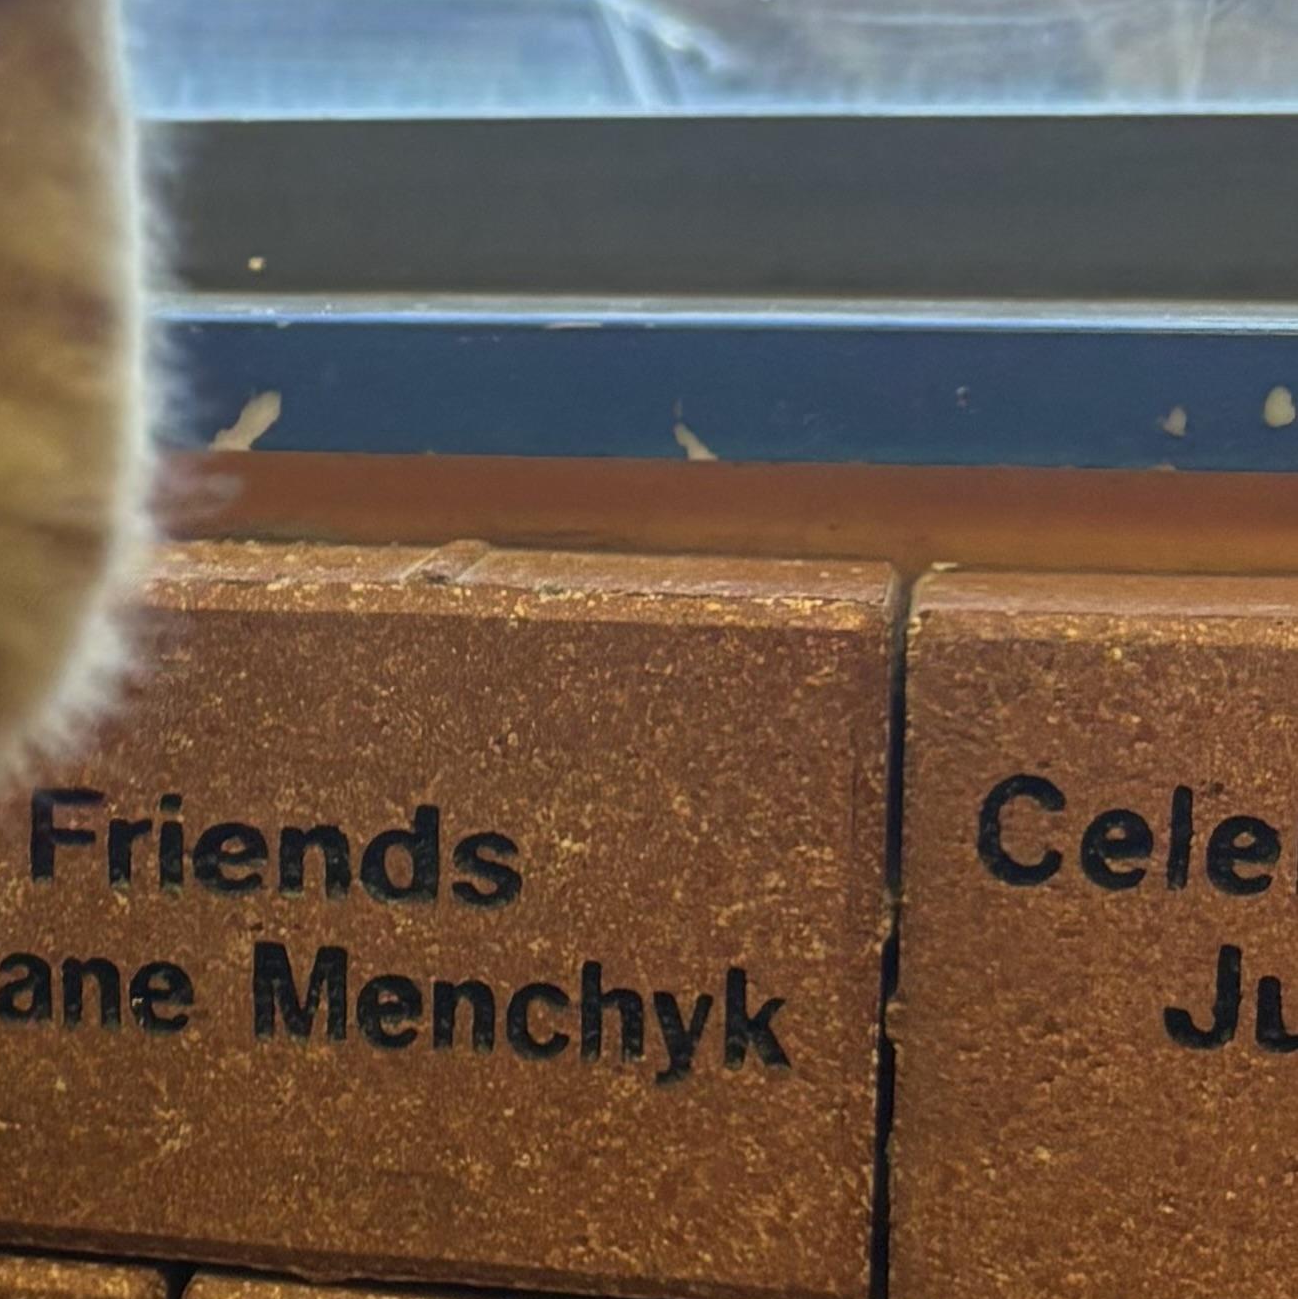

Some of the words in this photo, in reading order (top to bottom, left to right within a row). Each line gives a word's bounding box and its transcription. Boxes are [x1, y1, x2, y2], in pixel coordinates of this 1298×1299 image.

[30, 787, 522, 907] Friends
[976, 773, 1298, 895] Cele
[253, 941, 791, 1086] Menchyk
